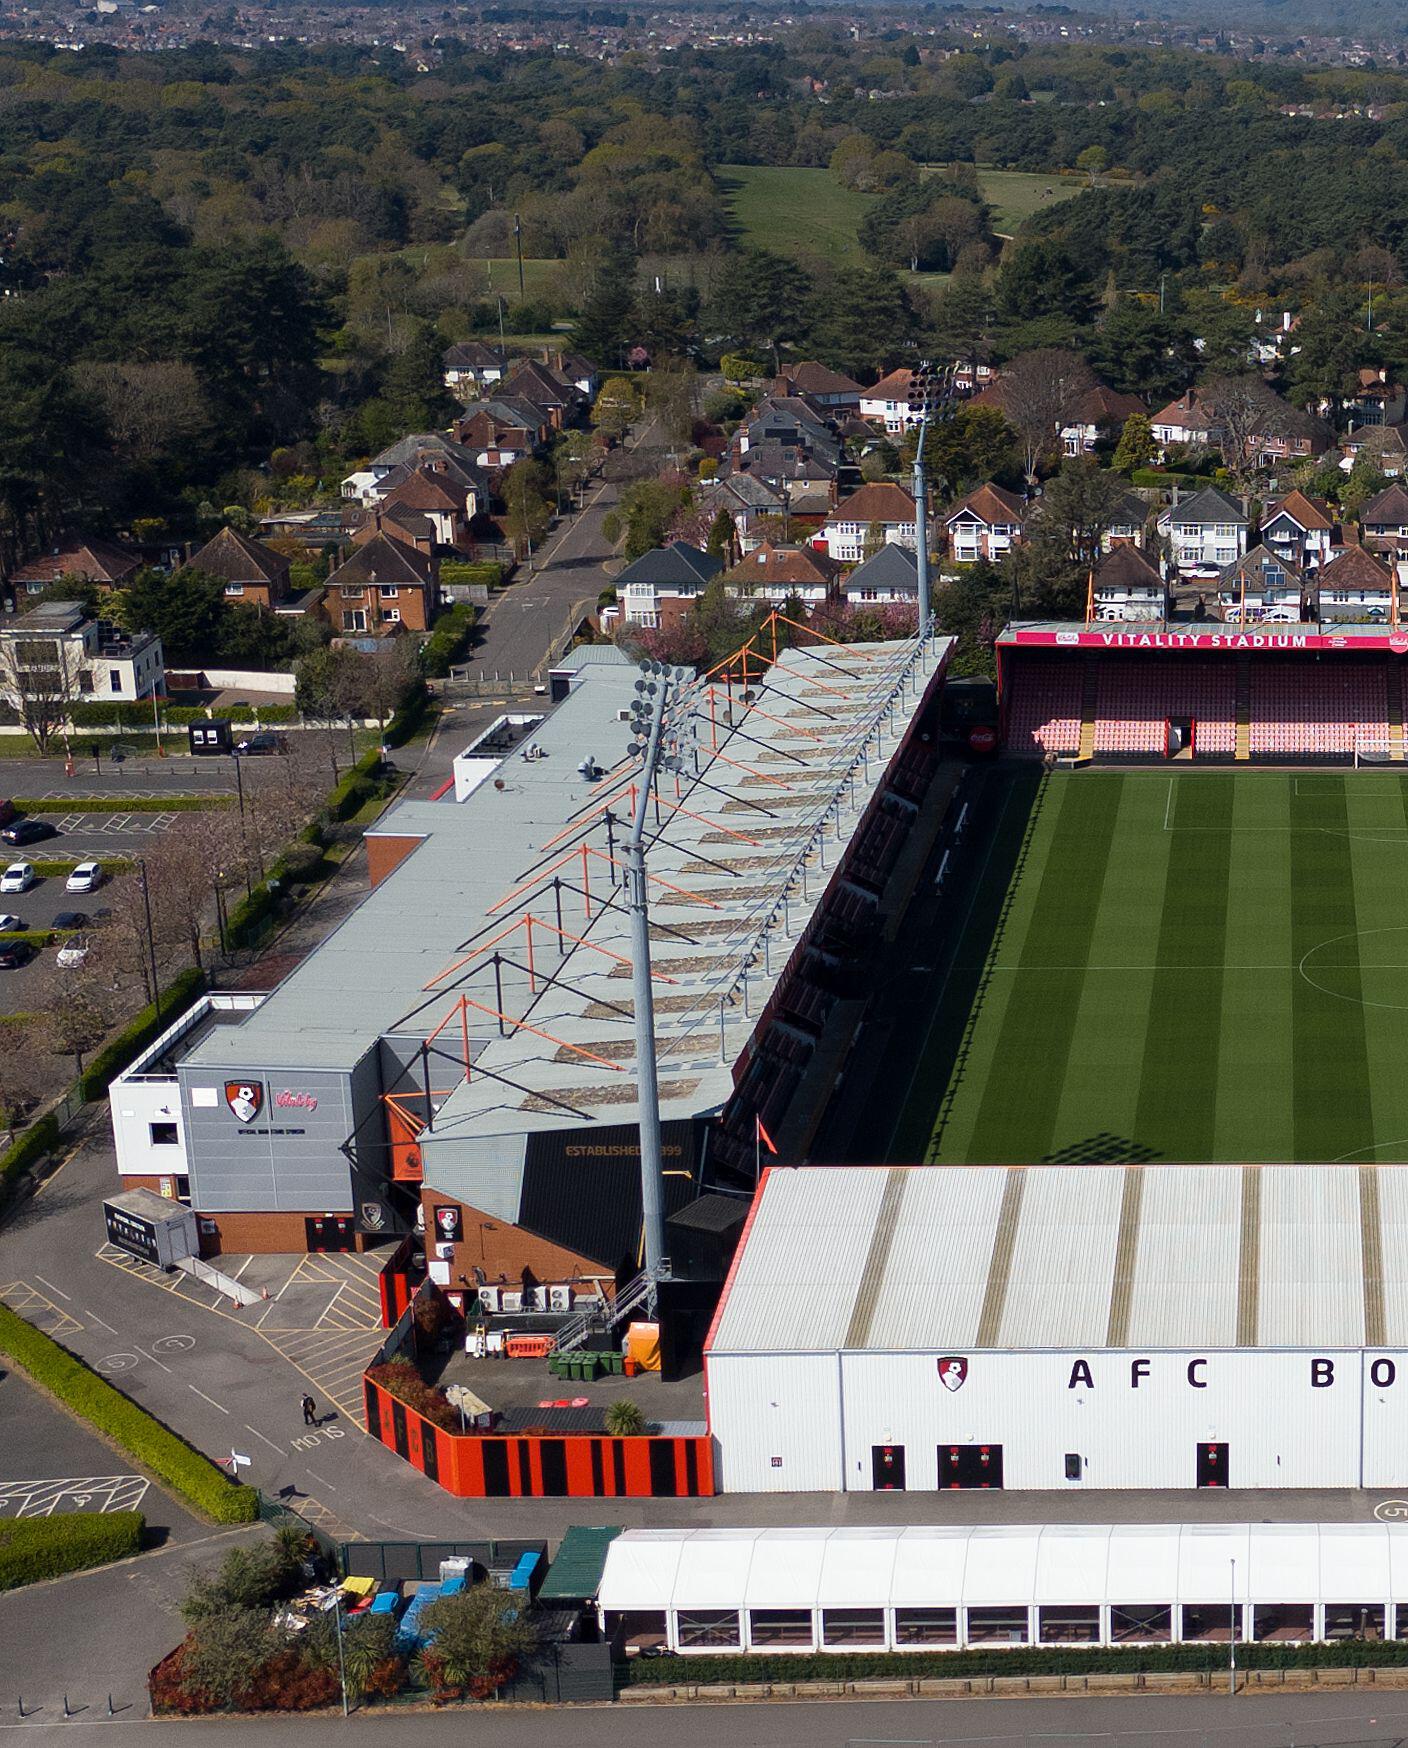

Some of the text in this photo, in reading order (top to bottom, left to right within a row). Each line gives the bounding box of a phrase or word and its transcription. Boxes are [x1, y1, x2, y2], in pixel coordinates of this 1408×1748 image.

[1103, 634, 1306, 647] VITALITY STADIUM
[1068, 1358, 1207, 1388] AFC
[290, 1425, 346, 1452] SLOW
